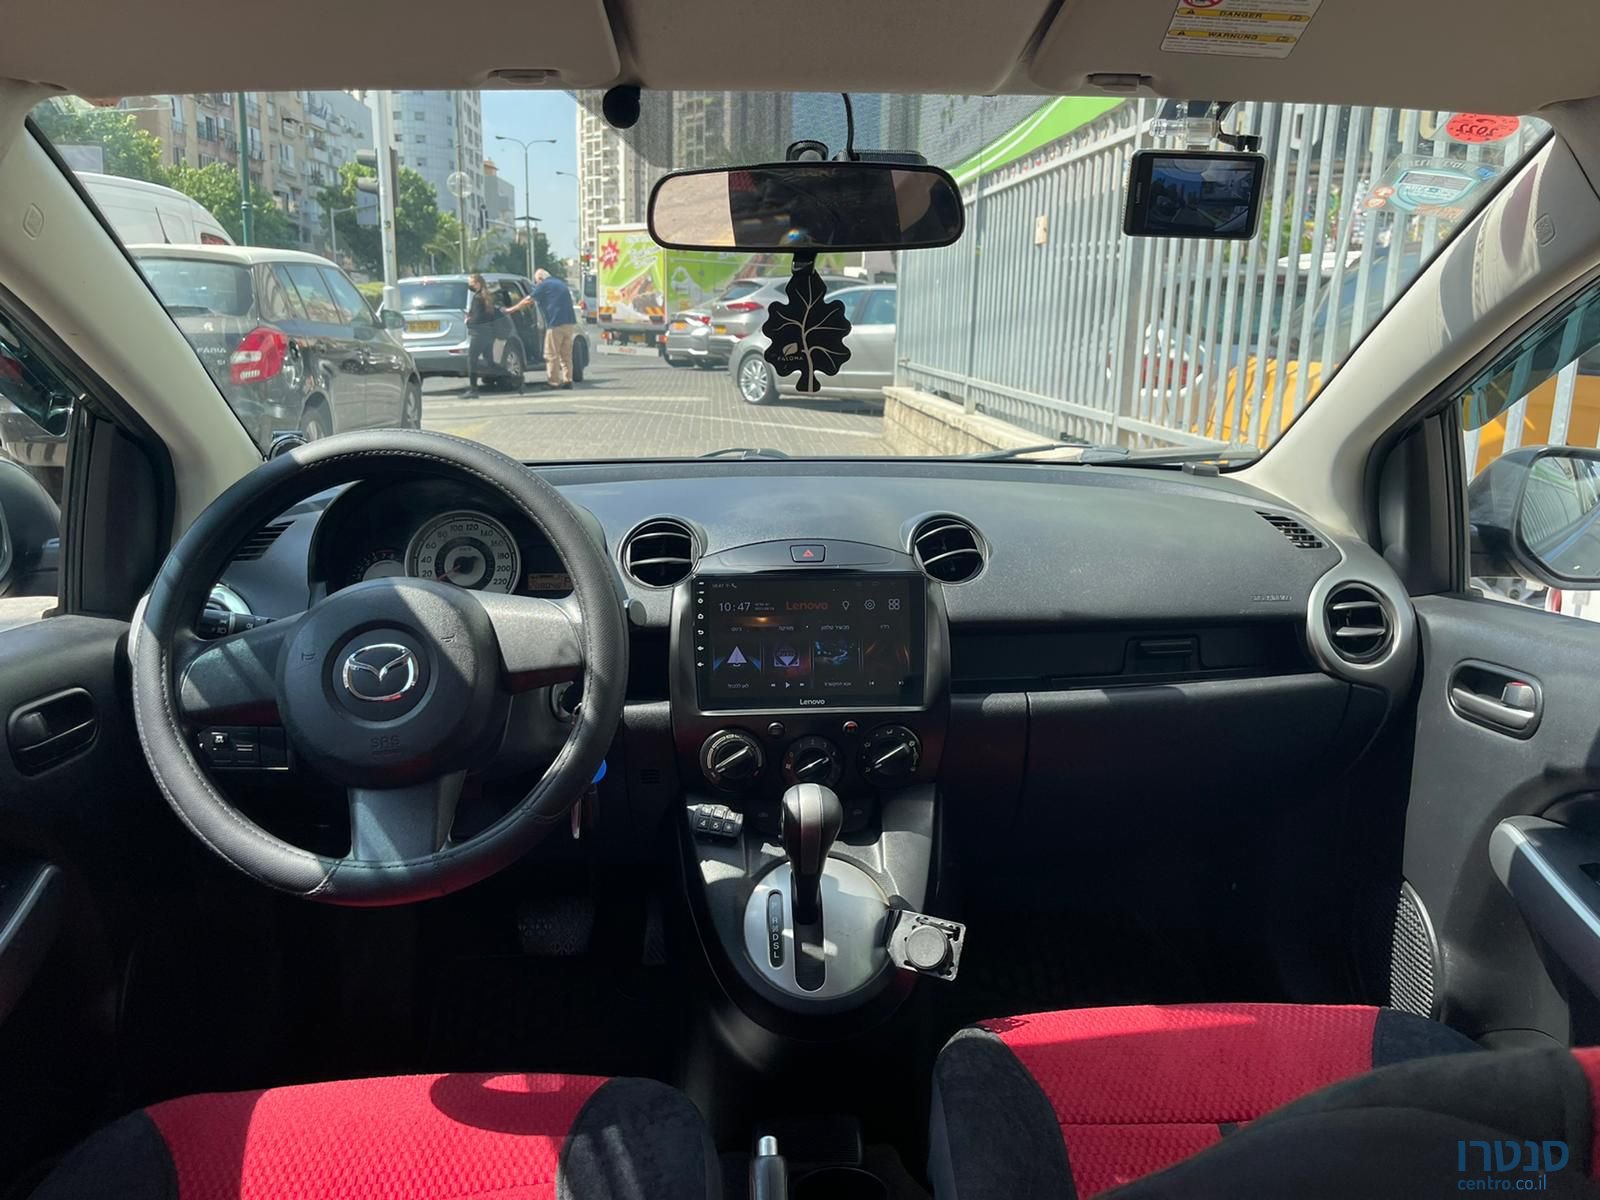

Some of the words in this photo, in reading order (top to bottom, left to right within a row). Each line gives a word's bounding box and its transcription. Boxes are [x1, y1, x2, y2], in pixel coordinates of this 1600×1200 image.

[1219, 10, 1263, 18] DANGER
[719, 601, 751, 613] 10:47
[785, 601, 829, 611] Lenovo
[799, 698, 826, 706] Lenovo
